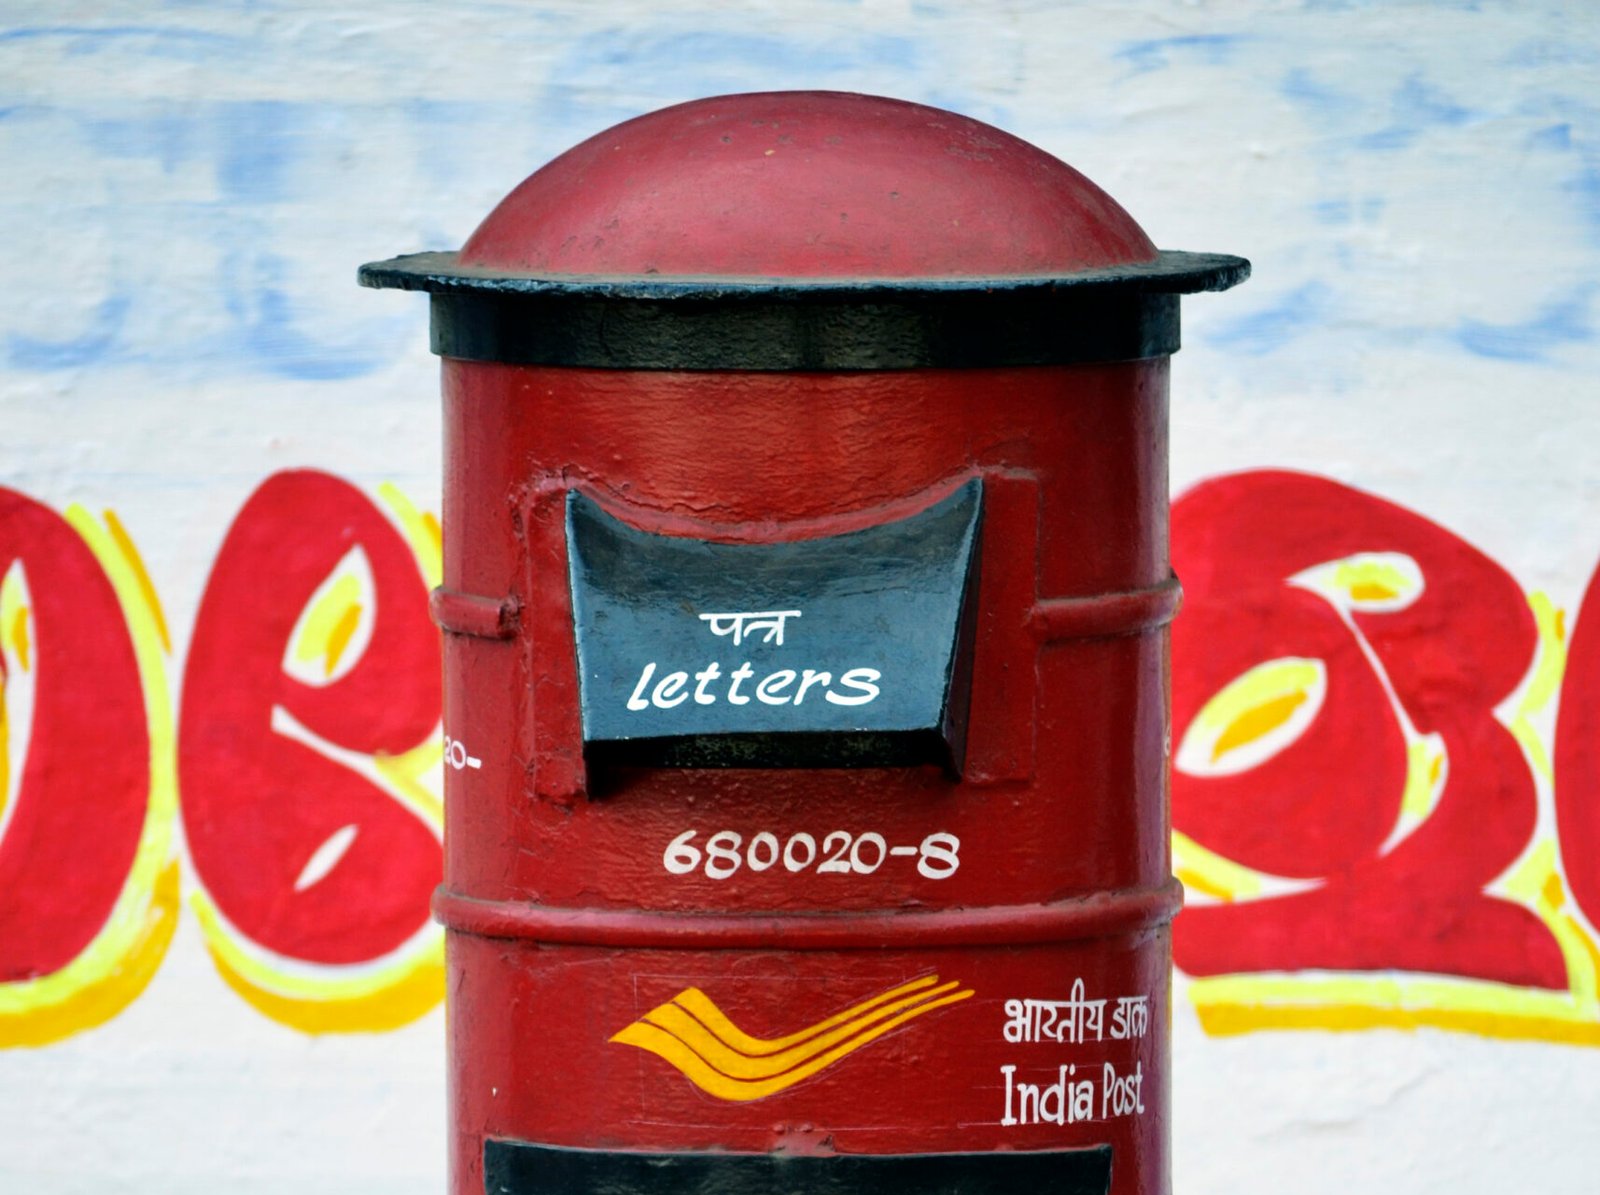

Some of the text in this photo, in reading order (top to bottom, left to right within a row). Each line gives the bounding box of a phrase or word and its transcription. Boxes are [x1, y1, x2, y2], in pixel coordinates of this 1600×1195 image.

[699, 610, 801, 646] पत्र
[662, 829, 961, 880] 680020-8
[1003, 977, 1148, 1044] भारतीय डाक
[1000, 1060, 1145, 1127] India Post
